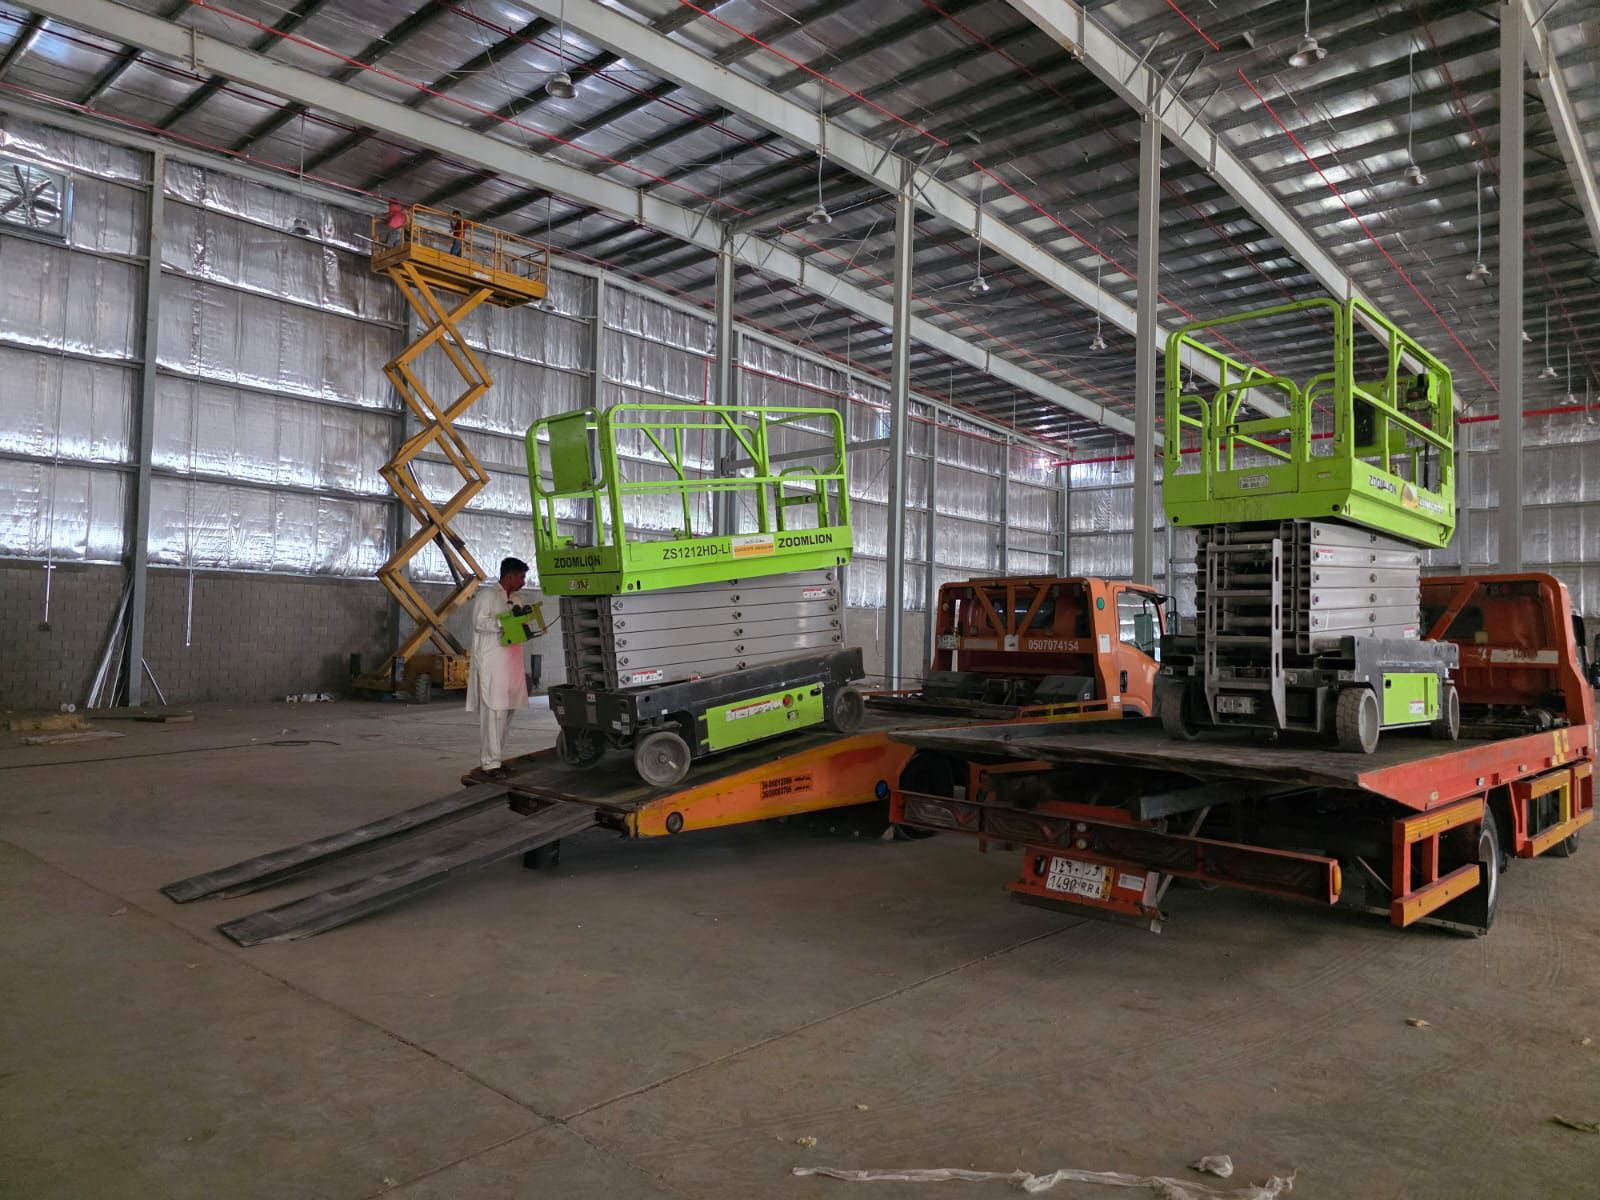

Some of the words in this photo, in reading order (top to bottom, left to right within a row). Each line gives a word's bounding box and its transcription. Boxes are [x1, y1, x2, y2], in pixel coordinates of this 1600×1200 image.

[778, 533, 833, 548] ZOOMLION
[663, 542, 731, 560] ZS1212HD-Li
[553, 554, 601, 569] ZOOMLION
[1028, 639, 1079, 651] 0507074154
